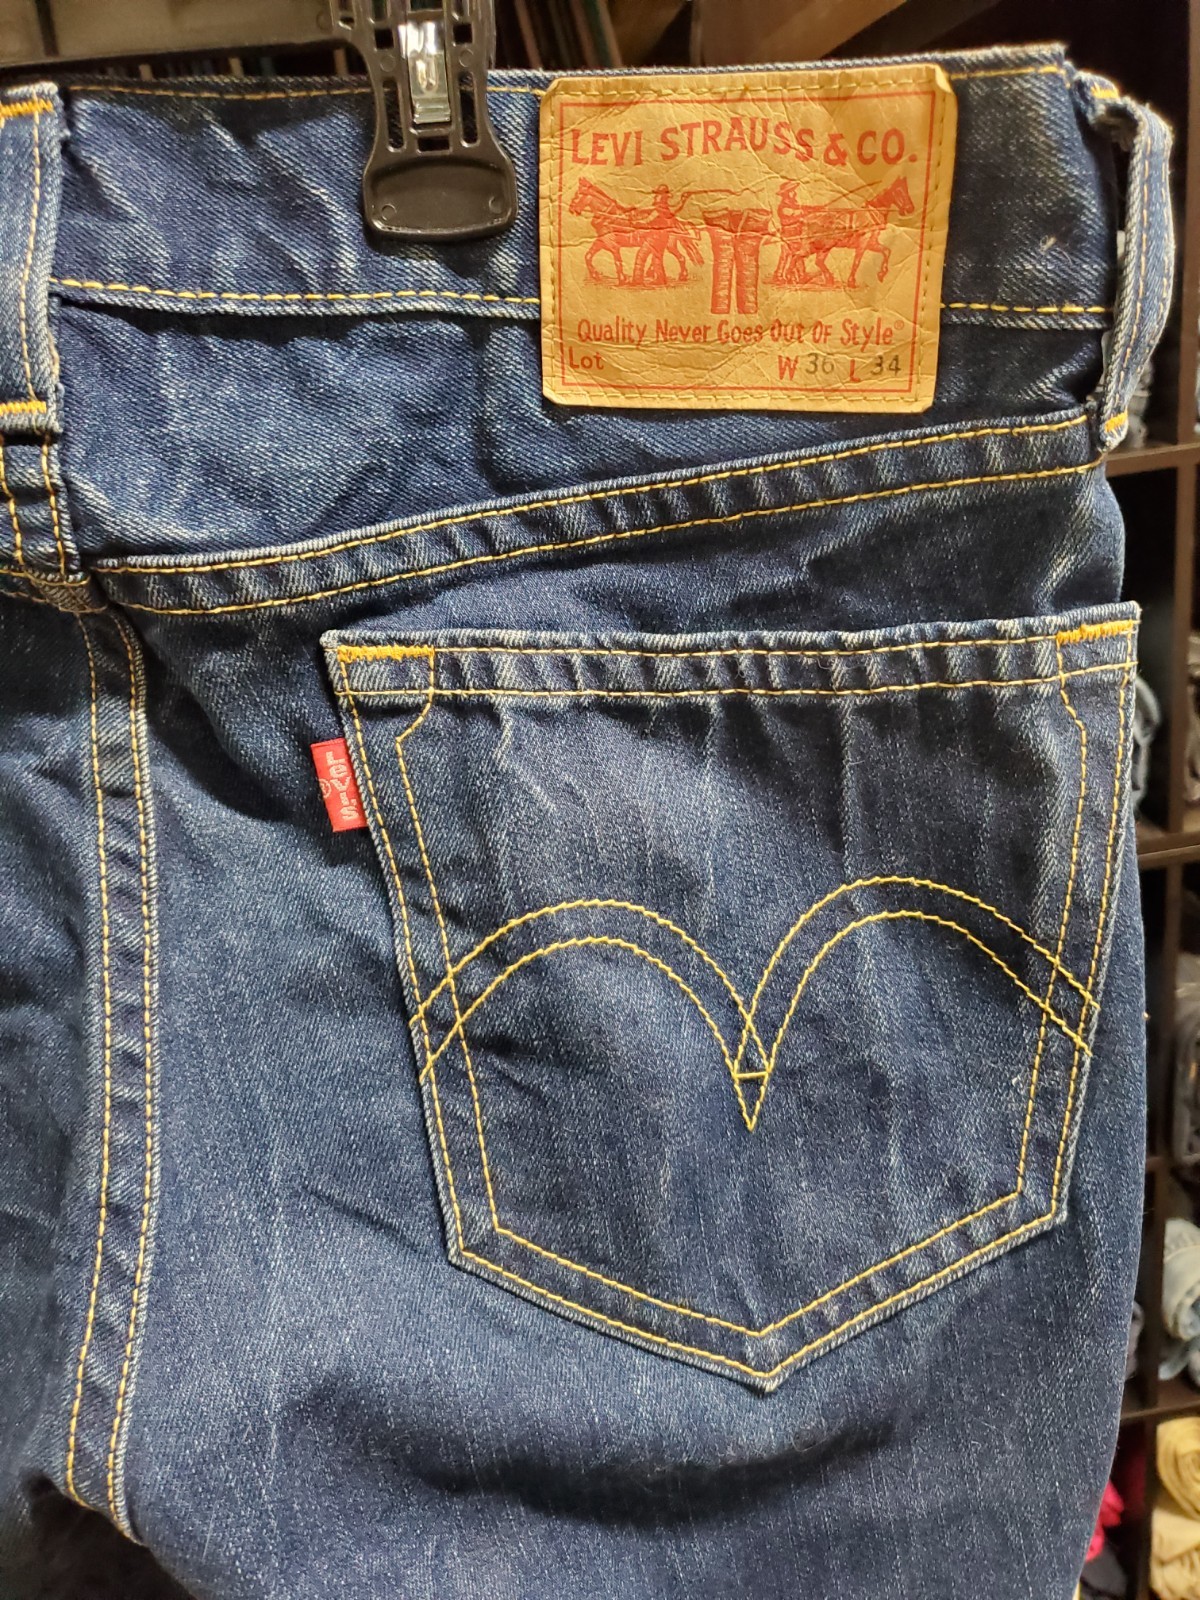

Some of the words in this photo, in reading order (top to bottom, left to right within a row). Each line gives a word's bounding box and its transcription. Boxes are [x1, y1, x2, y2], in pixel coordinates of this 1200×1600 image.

[570, 129, 642, 166] LEVI
[660, 117, 815, 162] STRAUSS
[823, 132, 847, 166] &
[856, 127, 918, 164] CO.
[577, 315, 647, 350] Quality
[655, 318, 712, 343] Never
[717, 319, 764, 344] Goes
[770, 318, 805, 343] Out
[840, 316, 894, 352] Style
[568, 346, 604, 370] Lot
[777, 354, 799, 381] W
[805, 352, 835, 375] 36
[849, 358, 861, 383] L
[870, 354, 902, 377] 34
